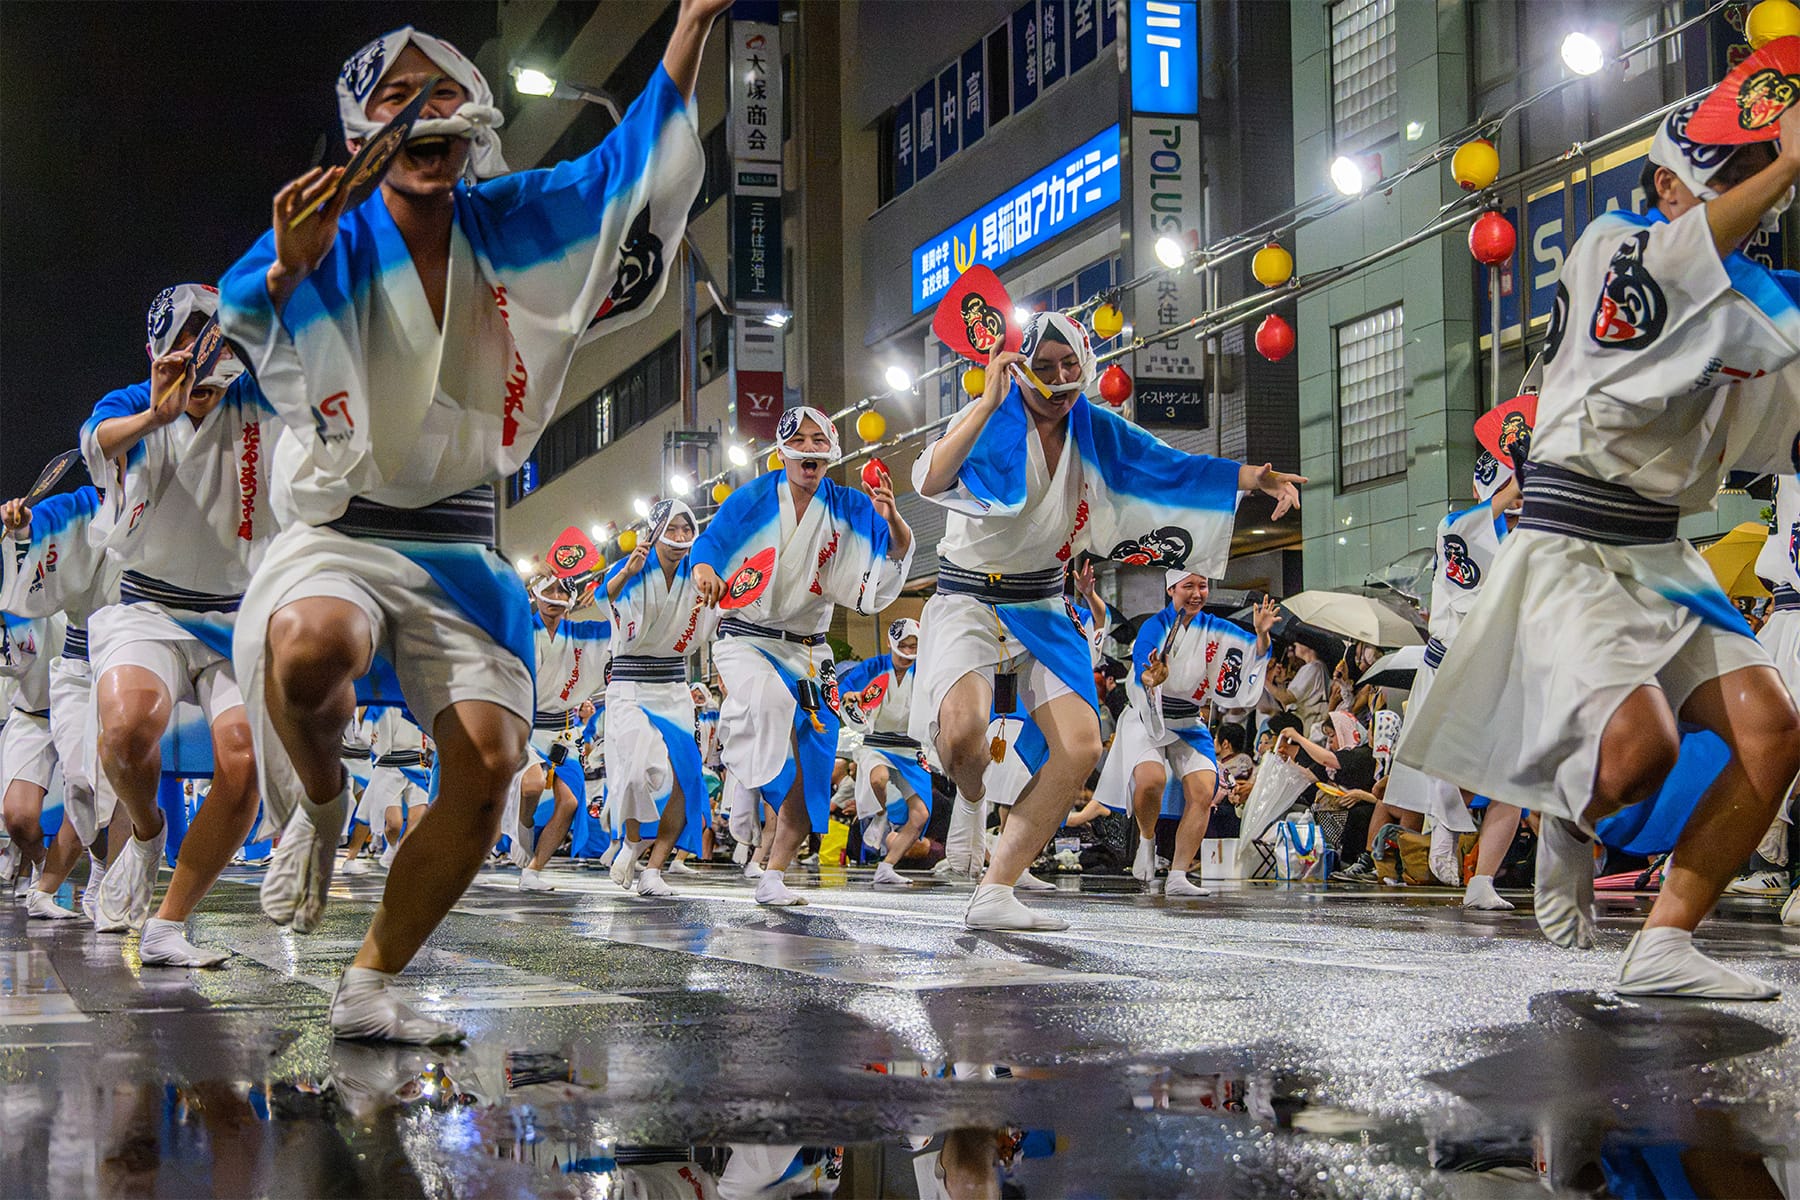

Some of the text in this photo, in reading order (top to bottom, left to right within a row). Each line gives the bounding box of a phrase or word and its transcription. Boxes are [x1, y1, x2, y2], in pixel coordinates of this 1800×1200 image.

[746, 54, 767, 150] 大塚商会
[899, 71, 981, 166] 早慶中高
[981, 150, 1119, 261] 早稲田アカデミー
[1149, 125, 1182, 236] POLUS
[921, 265, 950, 300] 高校受験
[1156, 268, 1179, 350] 央住宅
[1139, 391, 1200, 404] イーストサンビル
[1166, 406, 1175, 418] 3
